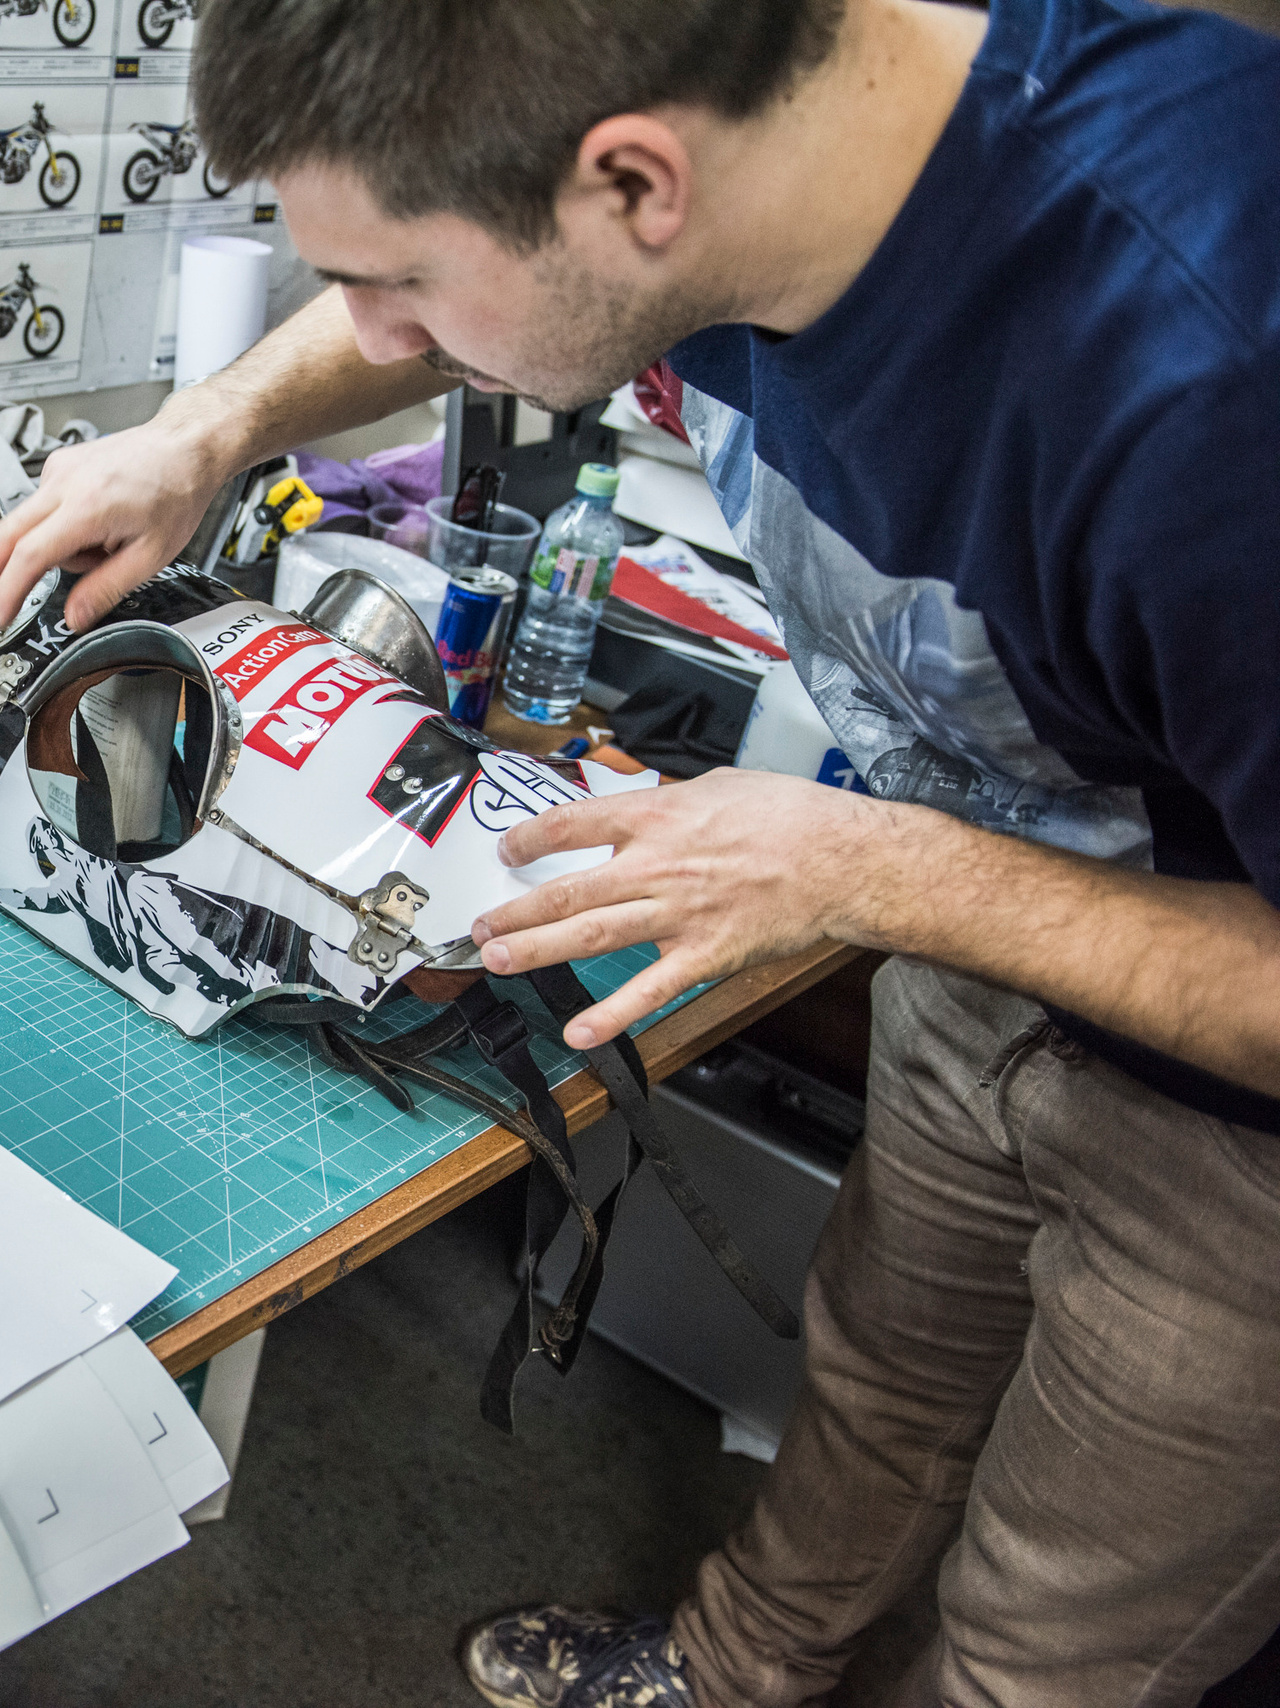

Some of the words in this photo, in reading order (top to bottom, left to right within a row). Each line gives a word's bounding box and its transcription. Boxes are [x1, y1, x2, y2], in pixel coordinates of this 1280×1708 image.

[202, 612, 265, 656] SONY
[263, 657, 400, 759] MOTUL
[453, 1128, 467, 1141] 10
[426, 1147, 437, 1158] 9
[396, 1166, 407, 1175] 8
[365, 1184, 376, 1194] 7
[334, 1204, 345, 1214] 6
[301, 1224, 313, 1234] 5
[267, 1246, 278, 1255] 4
[232, 1267, 243, 1277] 3
[195, 1290, 206, 1300] 2
